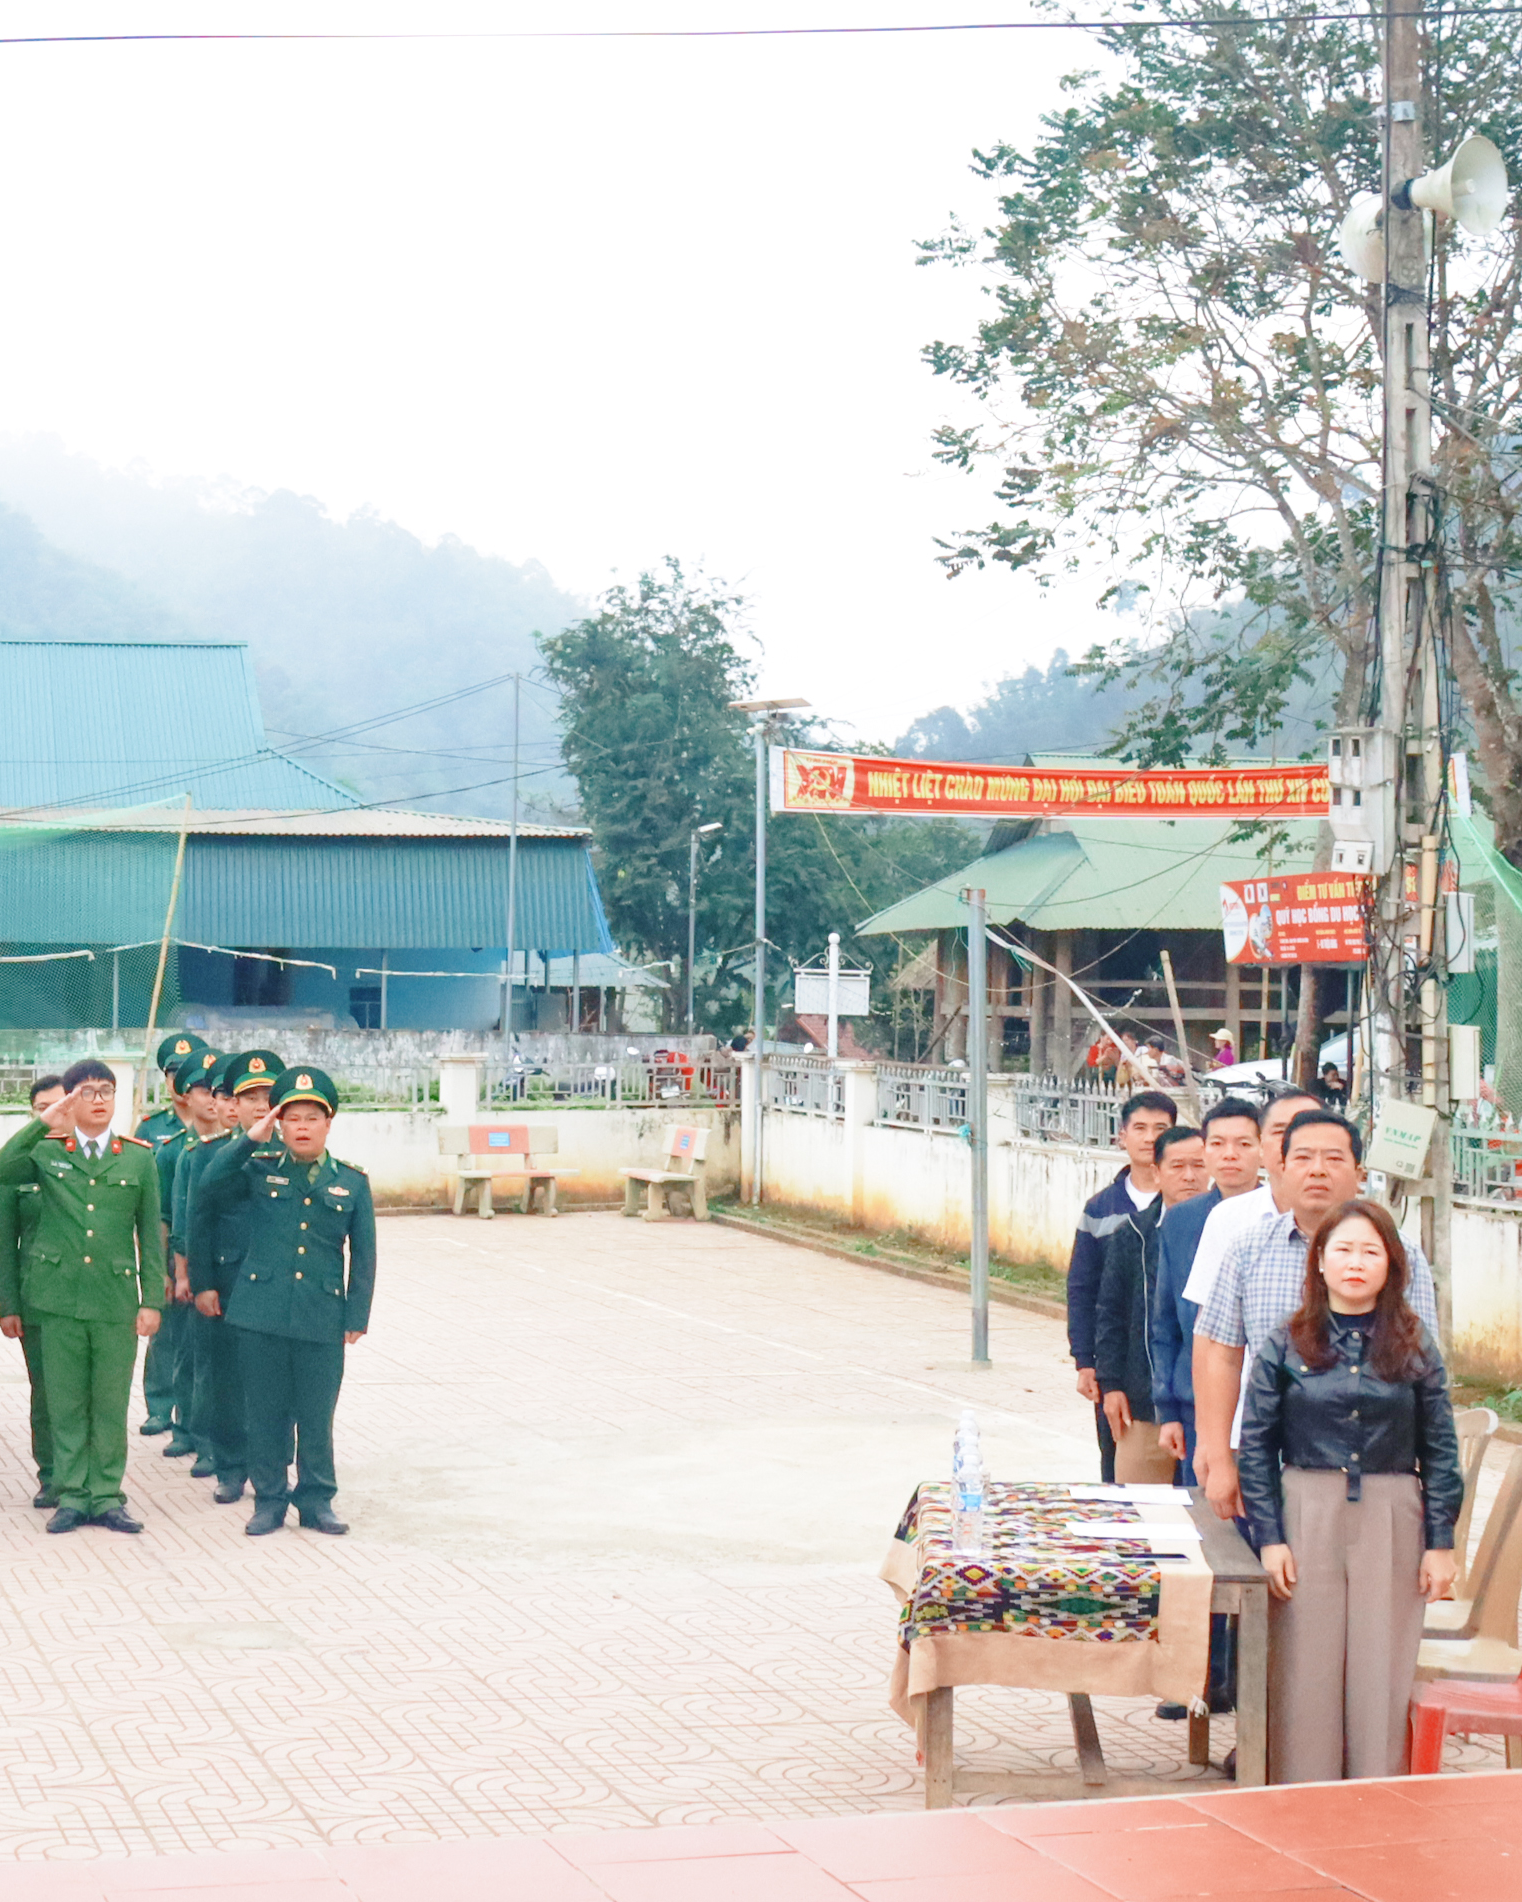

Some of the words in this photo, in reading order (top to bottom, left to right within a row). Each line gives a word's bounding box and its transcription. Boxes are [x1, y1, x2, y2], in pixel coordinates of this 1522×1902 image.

[867, 767, 910, 804] NHIỆT
[912, 769, 943, 805] LIỆT
[1187, 773, 1226, 806] QUỐC
